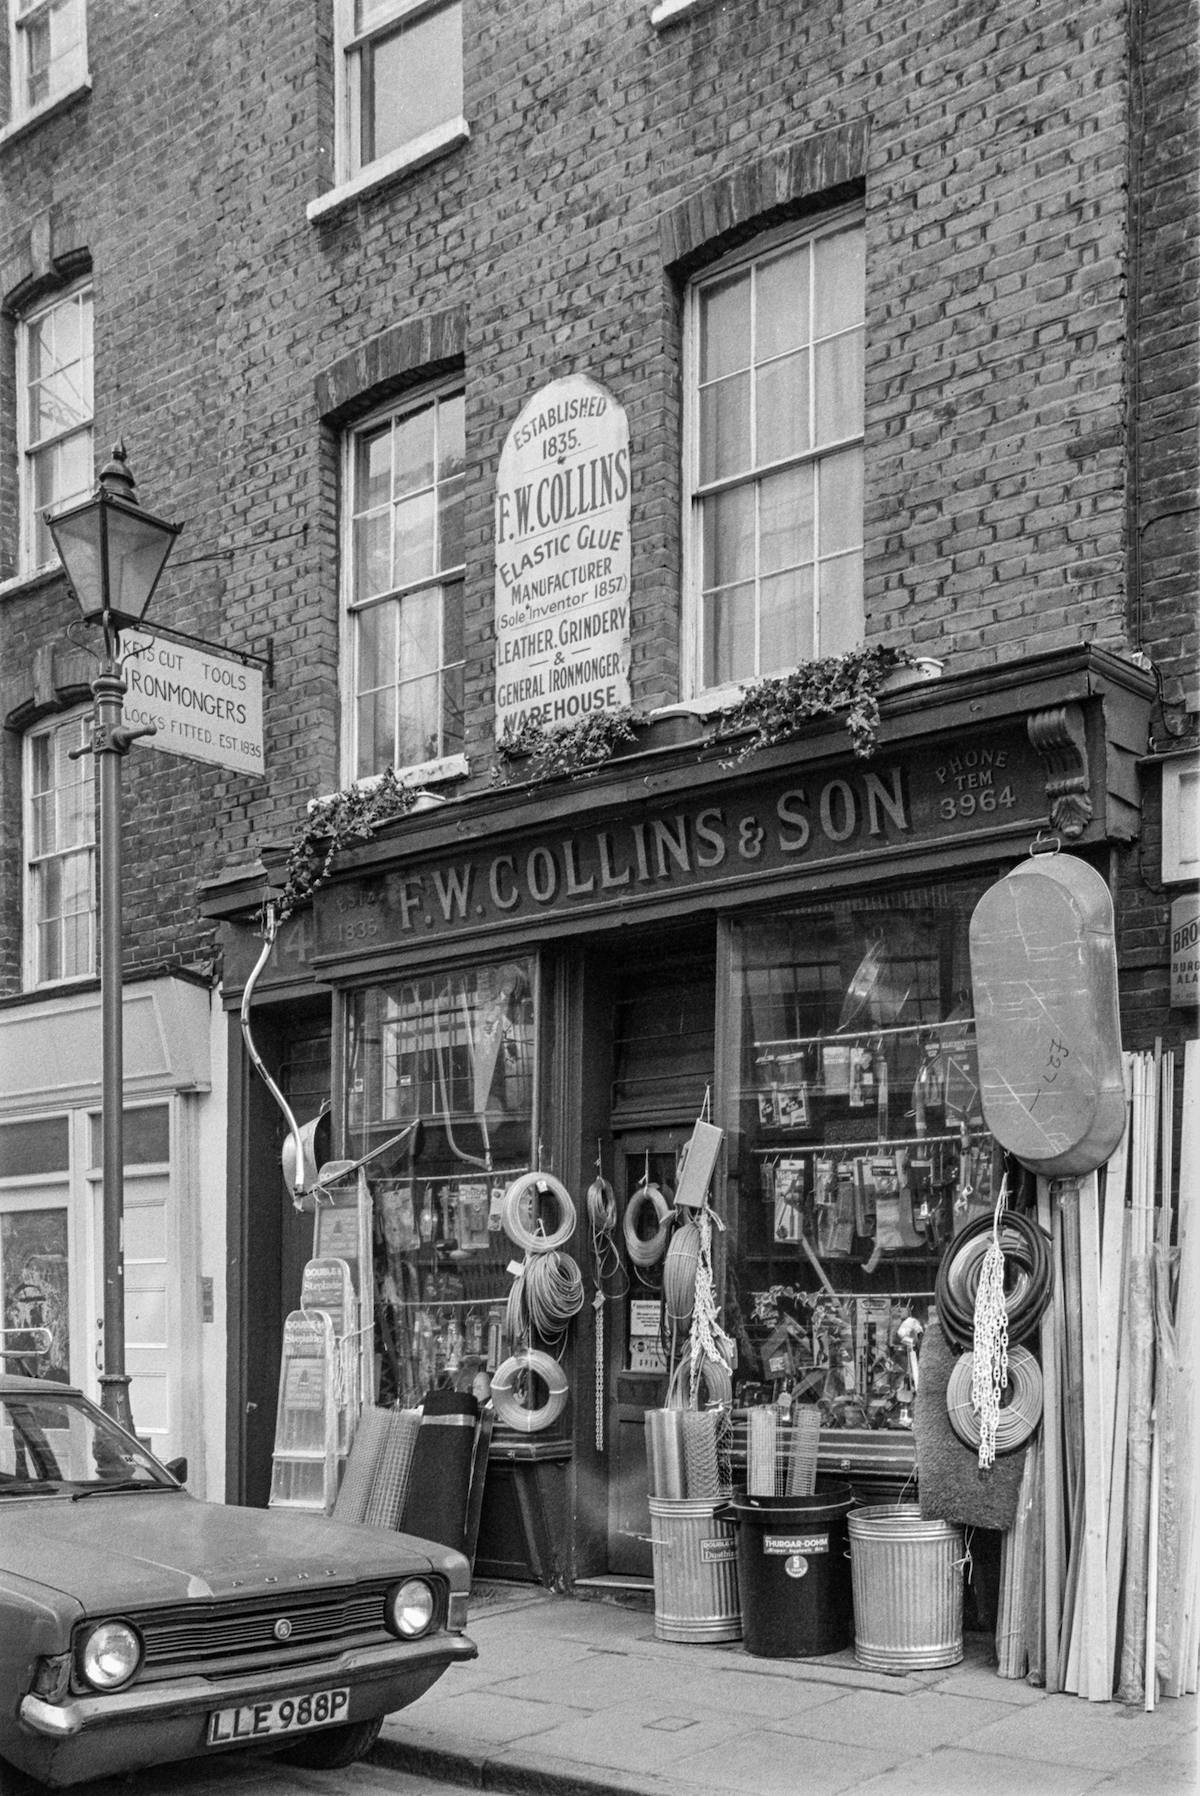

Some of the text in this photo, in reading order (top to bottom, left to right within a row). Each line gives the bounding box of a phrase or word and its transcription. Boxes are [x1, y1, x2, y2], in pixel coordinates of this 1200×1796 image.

[511, 396, 608, 451] ESTABLISHED
[542, 428, 582, 460] 1835.
[499, 524, 623, 588] ELASTIC GLUE
[511, 556, 612, 606] MANUFACTURER
[497, 573, 628, 632] (Sole Inventor 1857)
[558, 606, 627, 647] GRINDERY
[122, 639, 247, 691] KEYS CUT TOOLS
[553, 651, 565, 666] &
[125, 667, 247, 725] IRONMONGERS
[497, 674, 545, 708] GENERAL
[124, 706, 166, 731] LOCKS
[935, 748, 1009, 784] PHONE
[954, 768, 993, 792] TEM
[939, 785, 1016, 821] 3964
[489, 807, 727, 909] COLLINS
[738, 815, 764, 859] &
[776, 767, 909, 852] SON
[337, 917, 378, 942] 1835
[212, 1690, 348, 1742] LLE 988P
